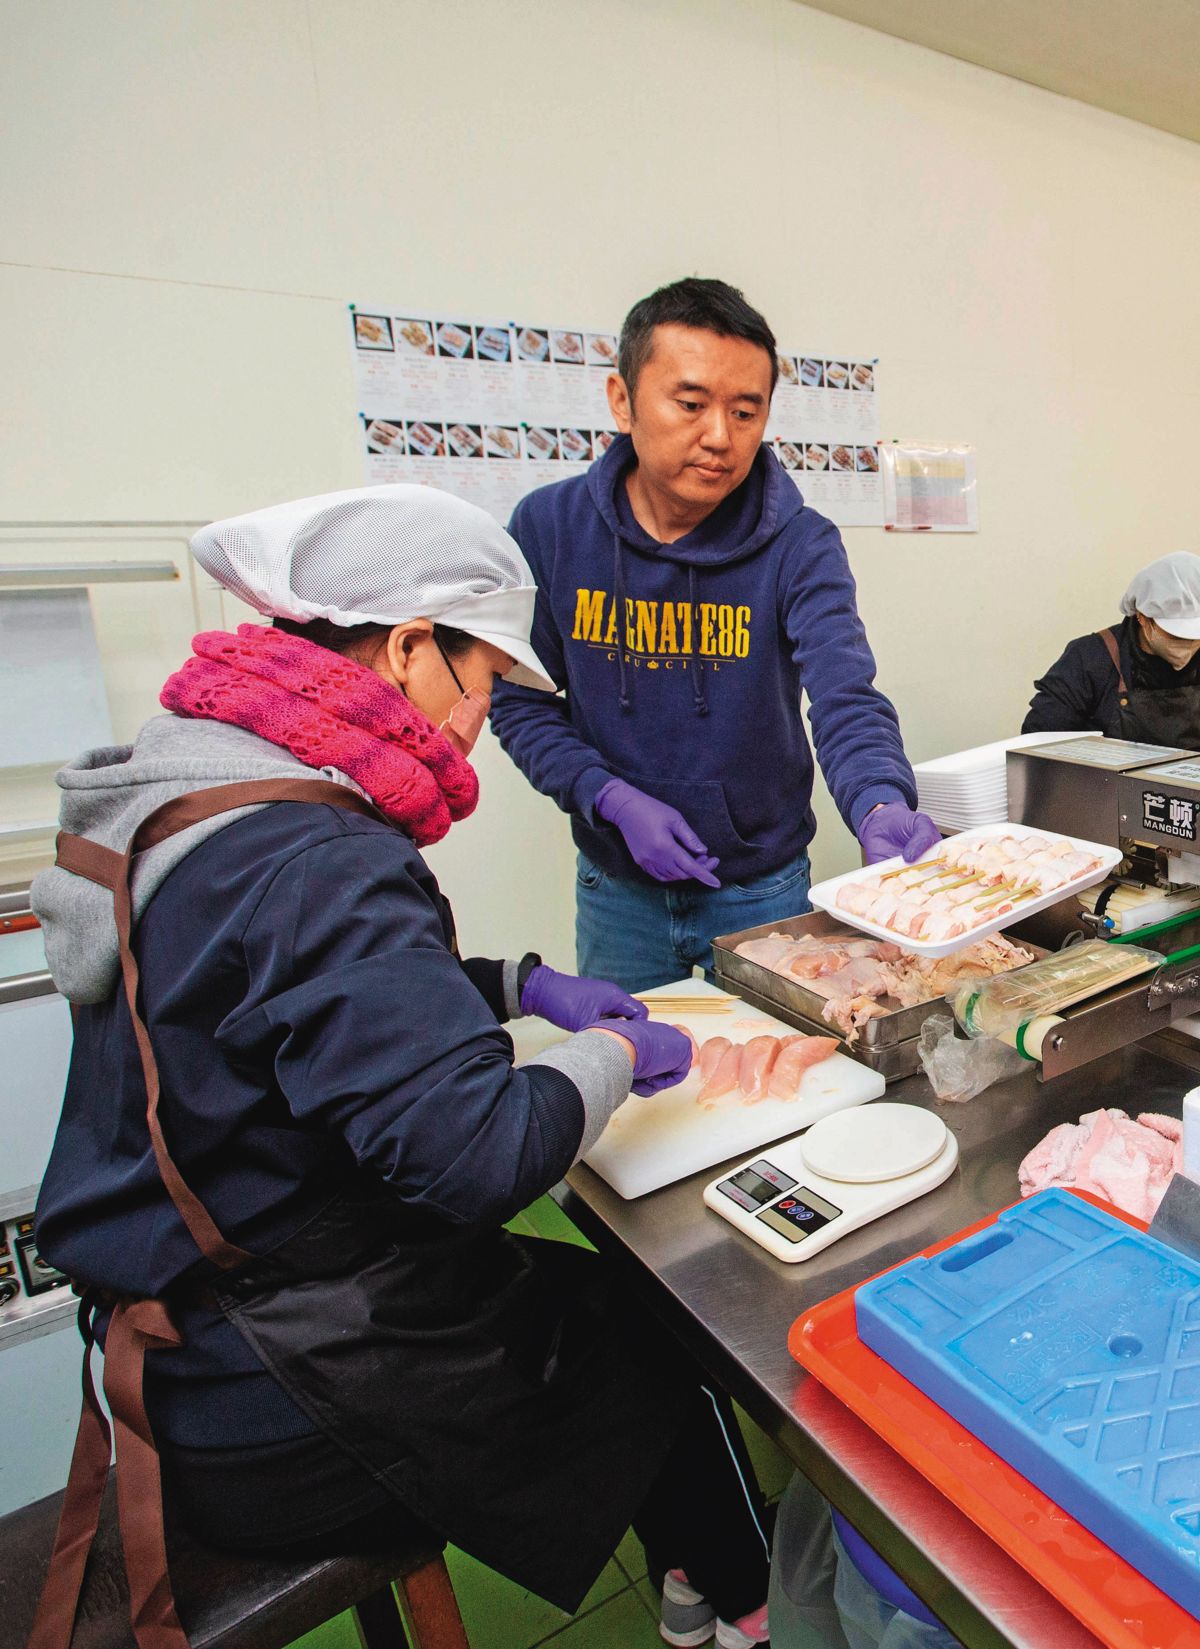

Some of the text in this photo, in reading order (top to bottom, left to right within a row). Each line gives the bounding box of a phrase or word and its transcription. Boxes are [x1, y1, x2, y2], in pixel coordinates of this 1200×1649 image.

[571, 588, 751, 658] MAGNATE86
[607, 652, 720, 671] CRUCIL
[1143, 793, 1193, 830] 芒顿
[1143, 819, 1193, 839] MANGDUN
